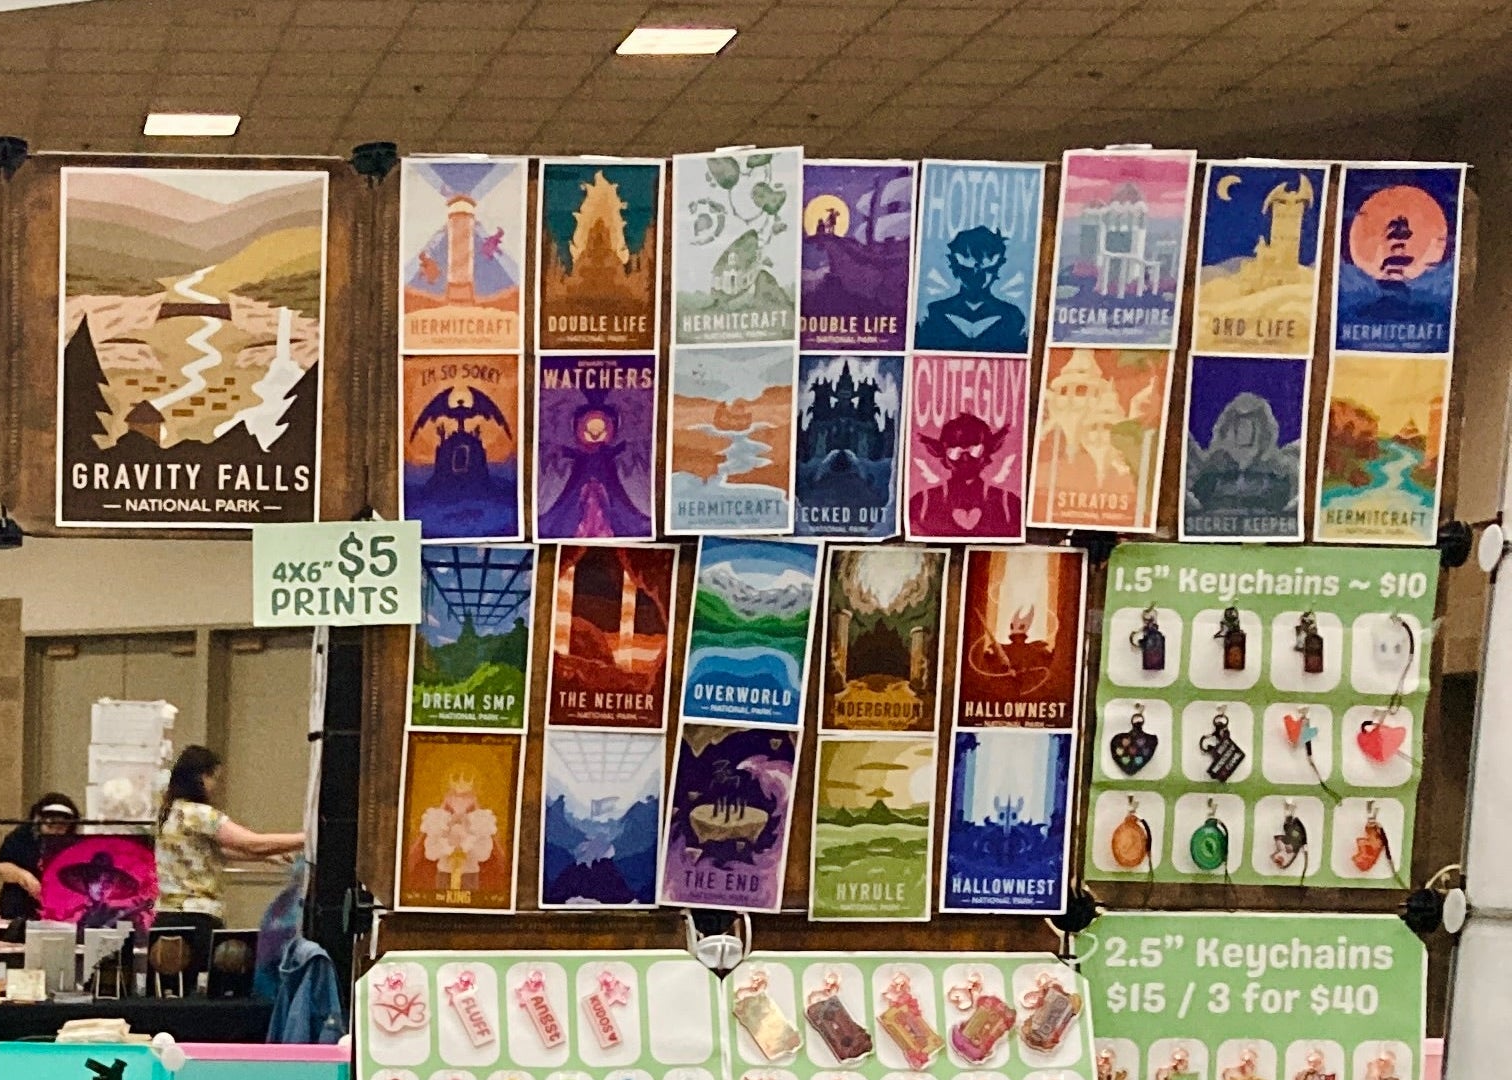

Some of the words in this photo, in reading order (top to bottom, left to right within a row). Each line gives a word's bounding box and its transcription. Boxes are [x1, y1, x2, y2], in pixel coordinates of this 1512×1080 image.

[410, 317, 513, 336] HERMITCRAFT
[548, 315, 609, 333] DOUBLE
[613, 315, 647, 332] LIFE
[682, 310, 788, 333] HERMITCRAFT
[800, 315, 858, 334] DOUBLE
[864, 316, 897, 334] LIFE
[1058, 307, 1109, 325] OCEAN
[1113, 307, 1172, 327] EMPIRE
[1256, 318, 1296, 339] LIFE
[440, 363, 458, 381] SO
[461, 363, 504, 385] SORRY
[543, 367, 653, 390] WATCHERS
[914, 354, 1025, 427] CUTEGUY
[71, 462, 202, 490] GRAVITY
[217, 463, 311, 492] FALLS
[125, 498, 211, 512] NATIONAL
[214, 499, 260, 513] PARK
[677, 499, 782, 519] HERMITCRAFT
[1056, 490, 1129, 510] STRATOS
[795, 506, 851, 523] ECKED
[859, 506, 889, 523] OUT
[1326, 508, 1426, 529] HERMITCRAFT
[337, 531, 399, 584] $5
[1178, 566, 1340, 602] Keychains
[1379, 572, 1428, 599] $10
[270, 586, 399, 617] PRINTS
[421, 692, 476, 711] DREAM
[482, 693, 516, 711] SMP
[559, 691, 589, 709] THE
[594, 693, 655, 711] NETHER
[693, 683, 792, 707] OVERWORLD
[964, 701, 1067, 719] HALLOWNEST
[685, 869, 717, 889] THE
[726, 872, 760, 892] END
[951, 877, 1056, 896] HALLOWNEST
[837, 881, 906, 902] HYRULE
[1196, 936, 1395, 978] Keychains
[1106, 981, 1167, 1015] $15
[1208, 982, 1231, 1013] 3
[1243, 981, 1300, 1013] for
[1310, 984, 1380, 1016] $40
[461, 997, 491, 1038] FLUFF
[589, 994, 615, 1034] KUDOS
